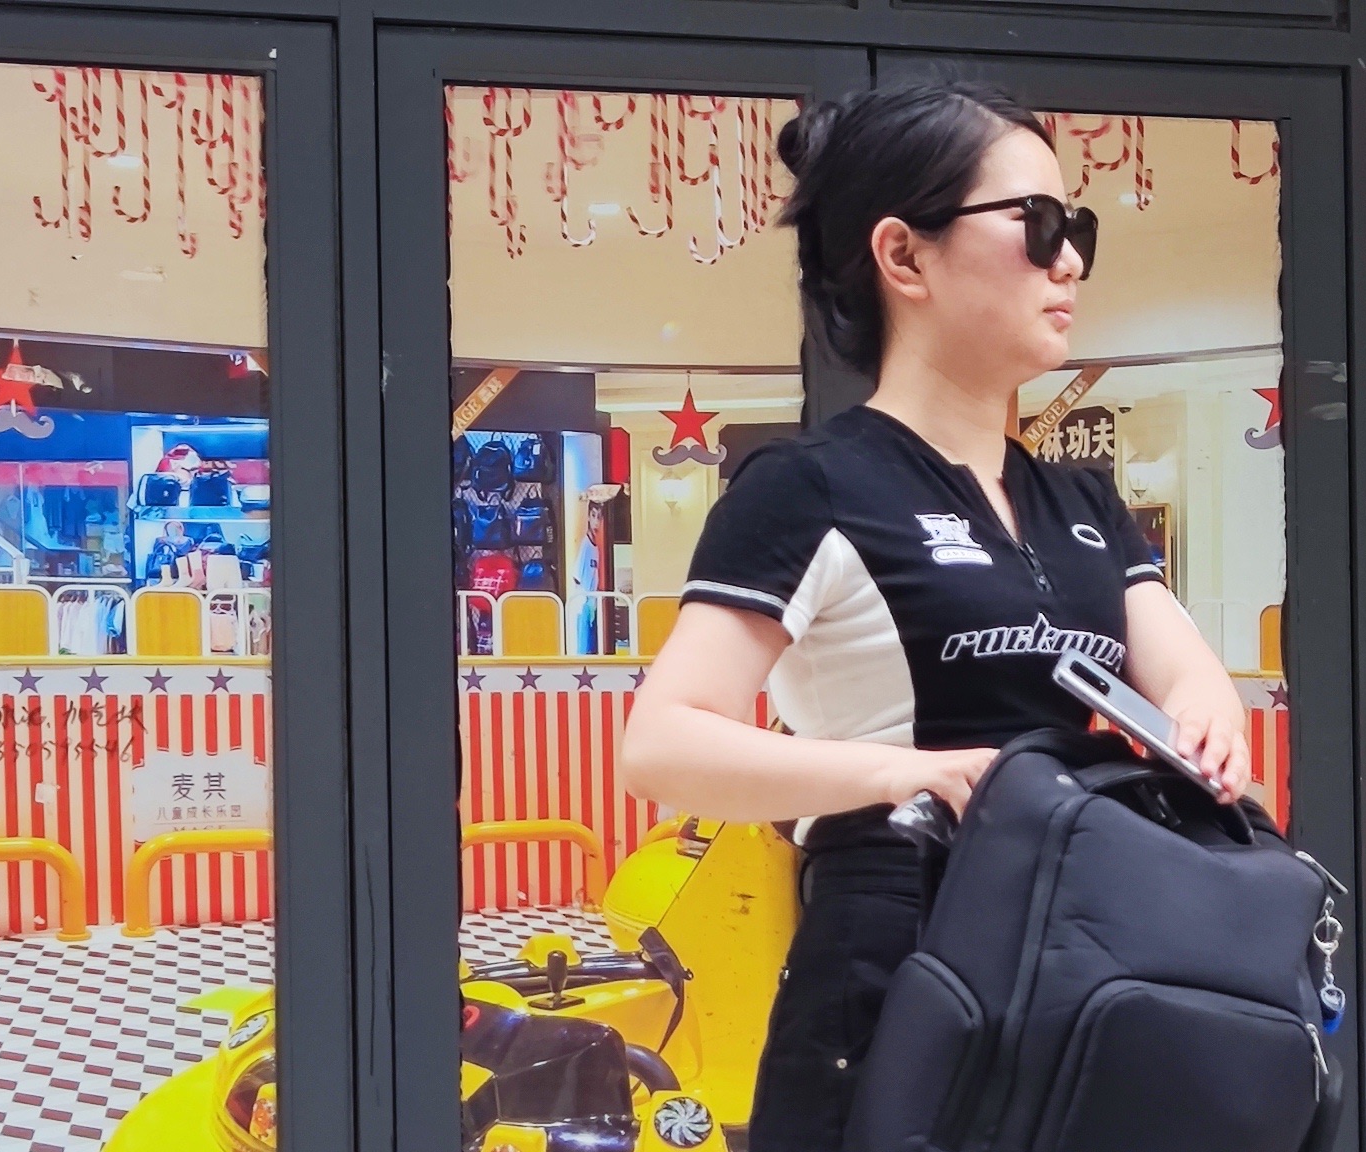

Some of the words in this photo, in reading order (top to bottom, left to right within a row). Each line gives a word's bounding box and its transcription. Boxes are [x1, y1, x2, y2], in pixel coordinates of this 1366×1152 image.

[452, 397, 483, 434] AGE
[1026, 401, 1065, 444] MAGE
[1032, 417, 1114, 463] 林功夫
[171, 772, 227, 802] 麦其
